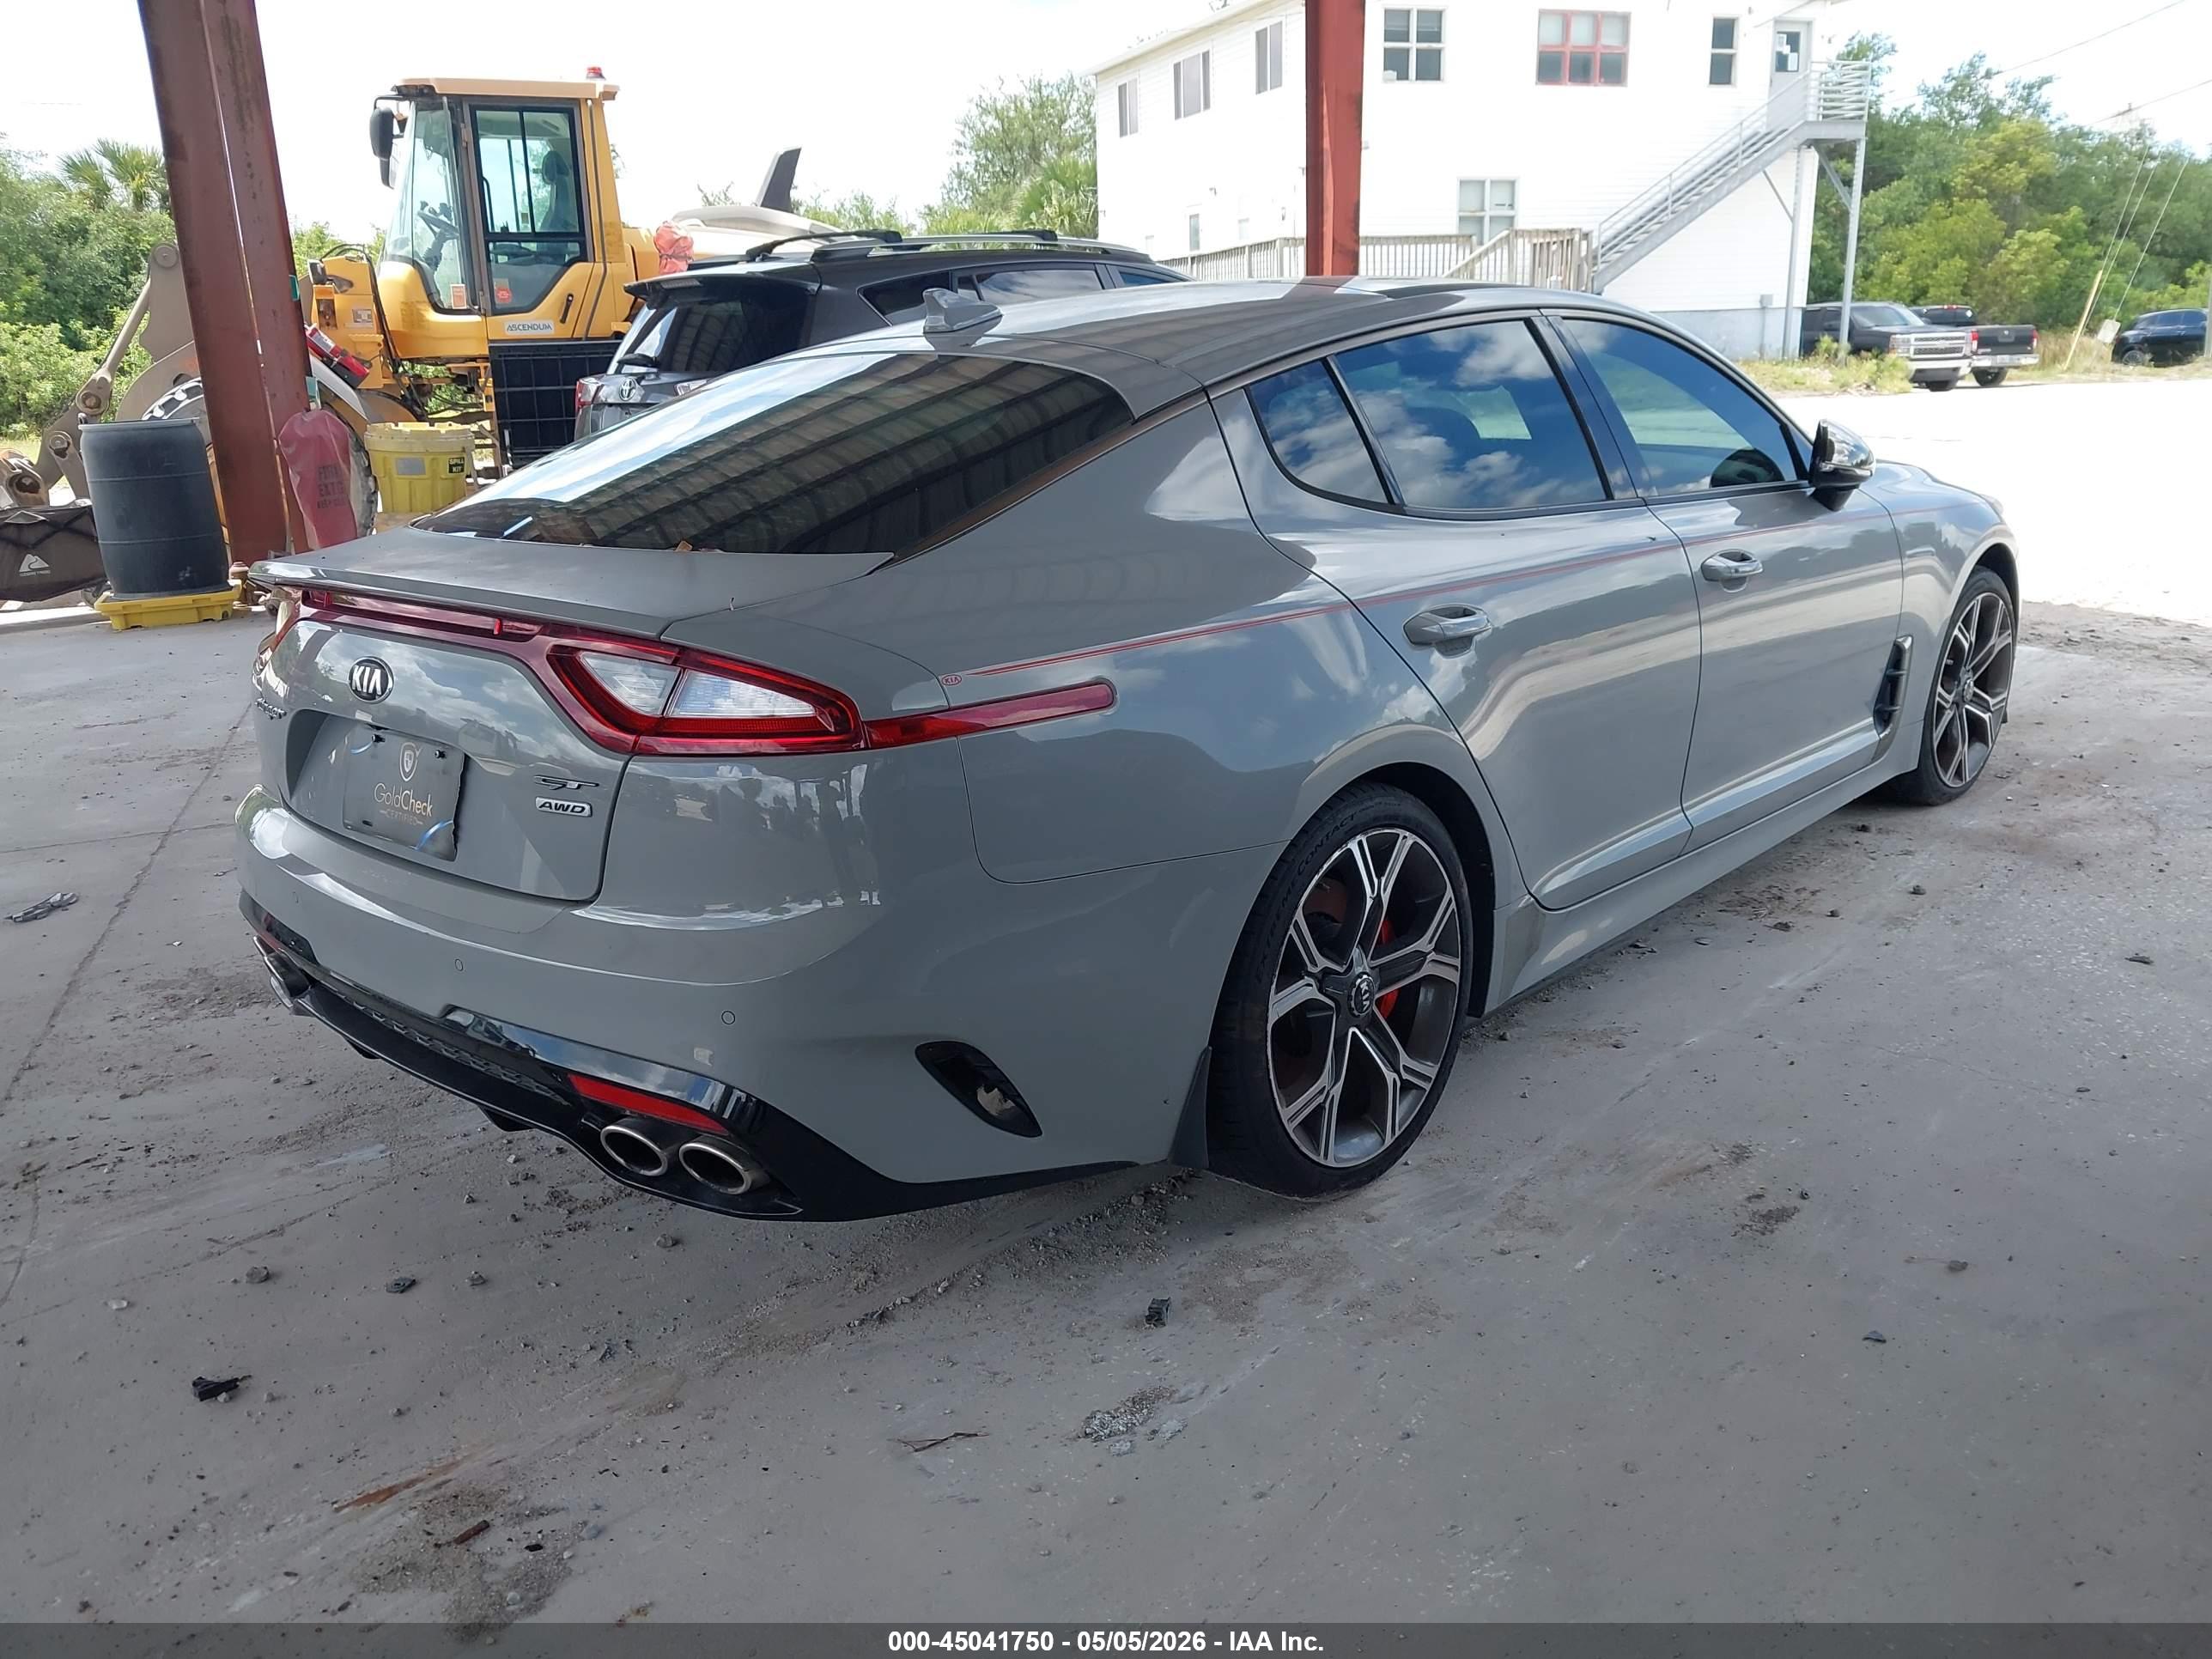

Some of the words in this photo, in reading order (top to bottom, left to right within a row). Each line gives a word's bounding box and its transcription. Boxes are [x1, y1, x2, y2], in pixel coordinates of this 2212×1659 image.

[506, 323, 553, 332] ASCENDUM
[352, 665, 383, 696] KIA
[374, 782, 433, 817] GoldCheck
[538, 801, 586, 814] AWD
[386, 808, 419, 826] CERTIFIED
